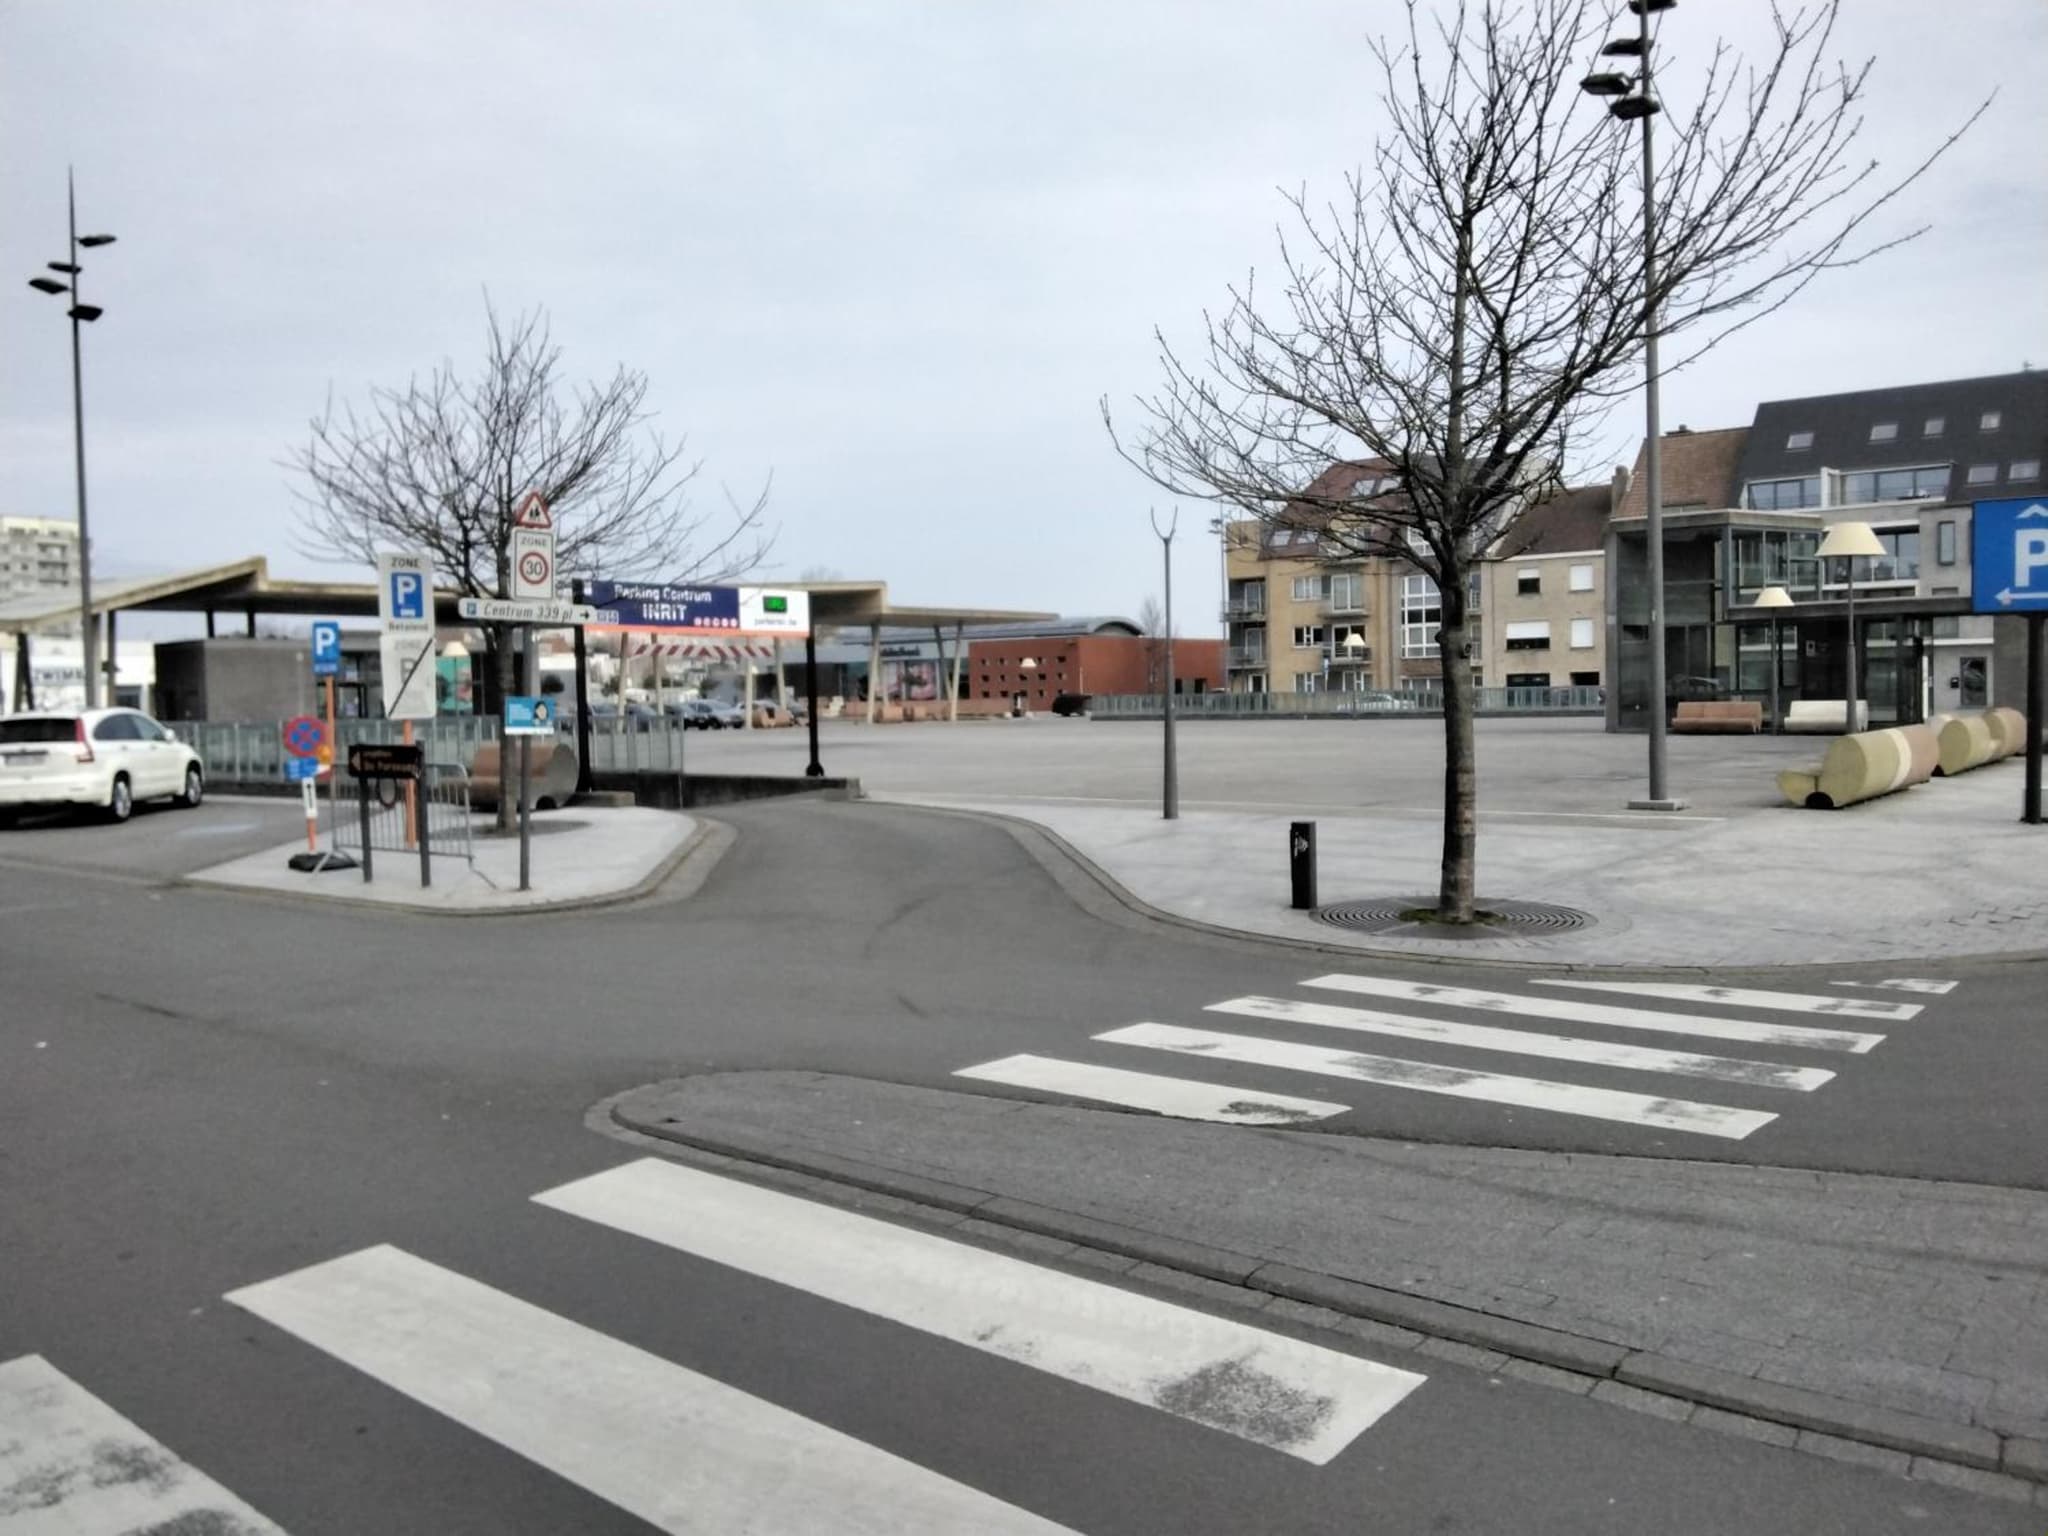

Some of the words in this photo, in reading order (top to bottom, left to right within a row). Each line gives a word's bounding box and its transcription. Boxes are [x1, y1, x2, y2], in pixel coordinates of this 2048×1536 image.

[522, 535, 548, 547] ZONE
[391, 556, 420, 569] ZONE
[2014, 528, 2048, 587] P
[526, 560, 543, 576] 30
[397, 575, 416, 605] P
[614, 584, 660, 600] Parking
[663, 587, 712, 603] Centrum
[483, 603, 533, 618] Centrum
[537, 604, 560, 618] 339
[562, 606, 574, 623] pl
[315, 627, 336, 656] P
